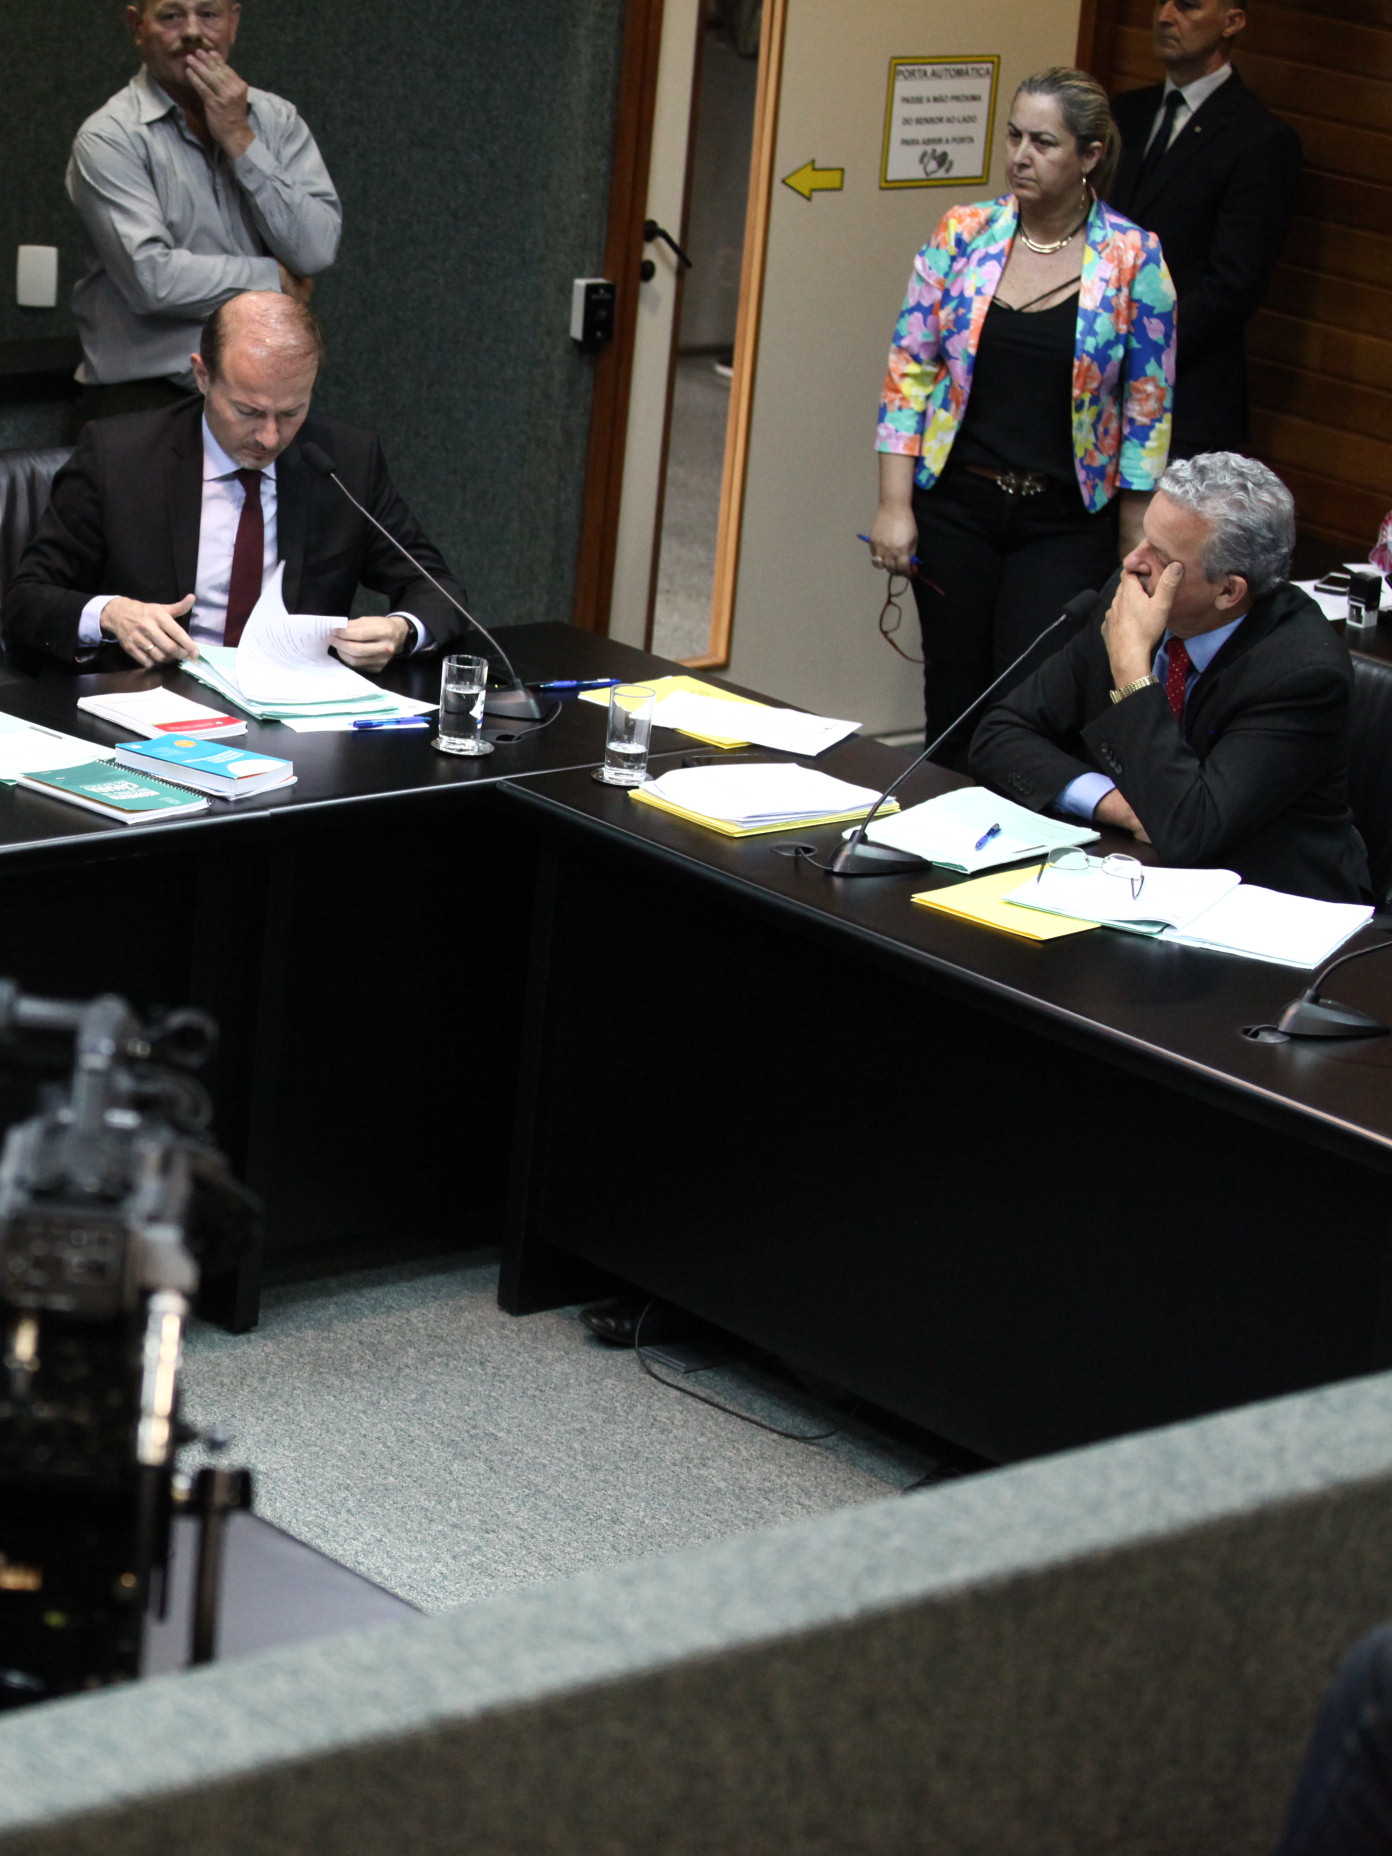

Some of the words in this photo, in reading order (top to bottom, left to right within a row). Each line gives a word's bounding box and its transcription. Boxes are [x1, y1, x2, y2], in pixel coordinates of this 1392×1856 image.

[896, 68, 927, 79] PORTA
[931, 66, 992, 78] AUTOMÁTICA
[901, 95, 923, 104] PASSE
[915, 115, 944, 125] SENSOR
[901, 138, 920, 146] PARA
[922, 137, 943, 145] ABRIR
[951, 136, 975, 144] PORTA
